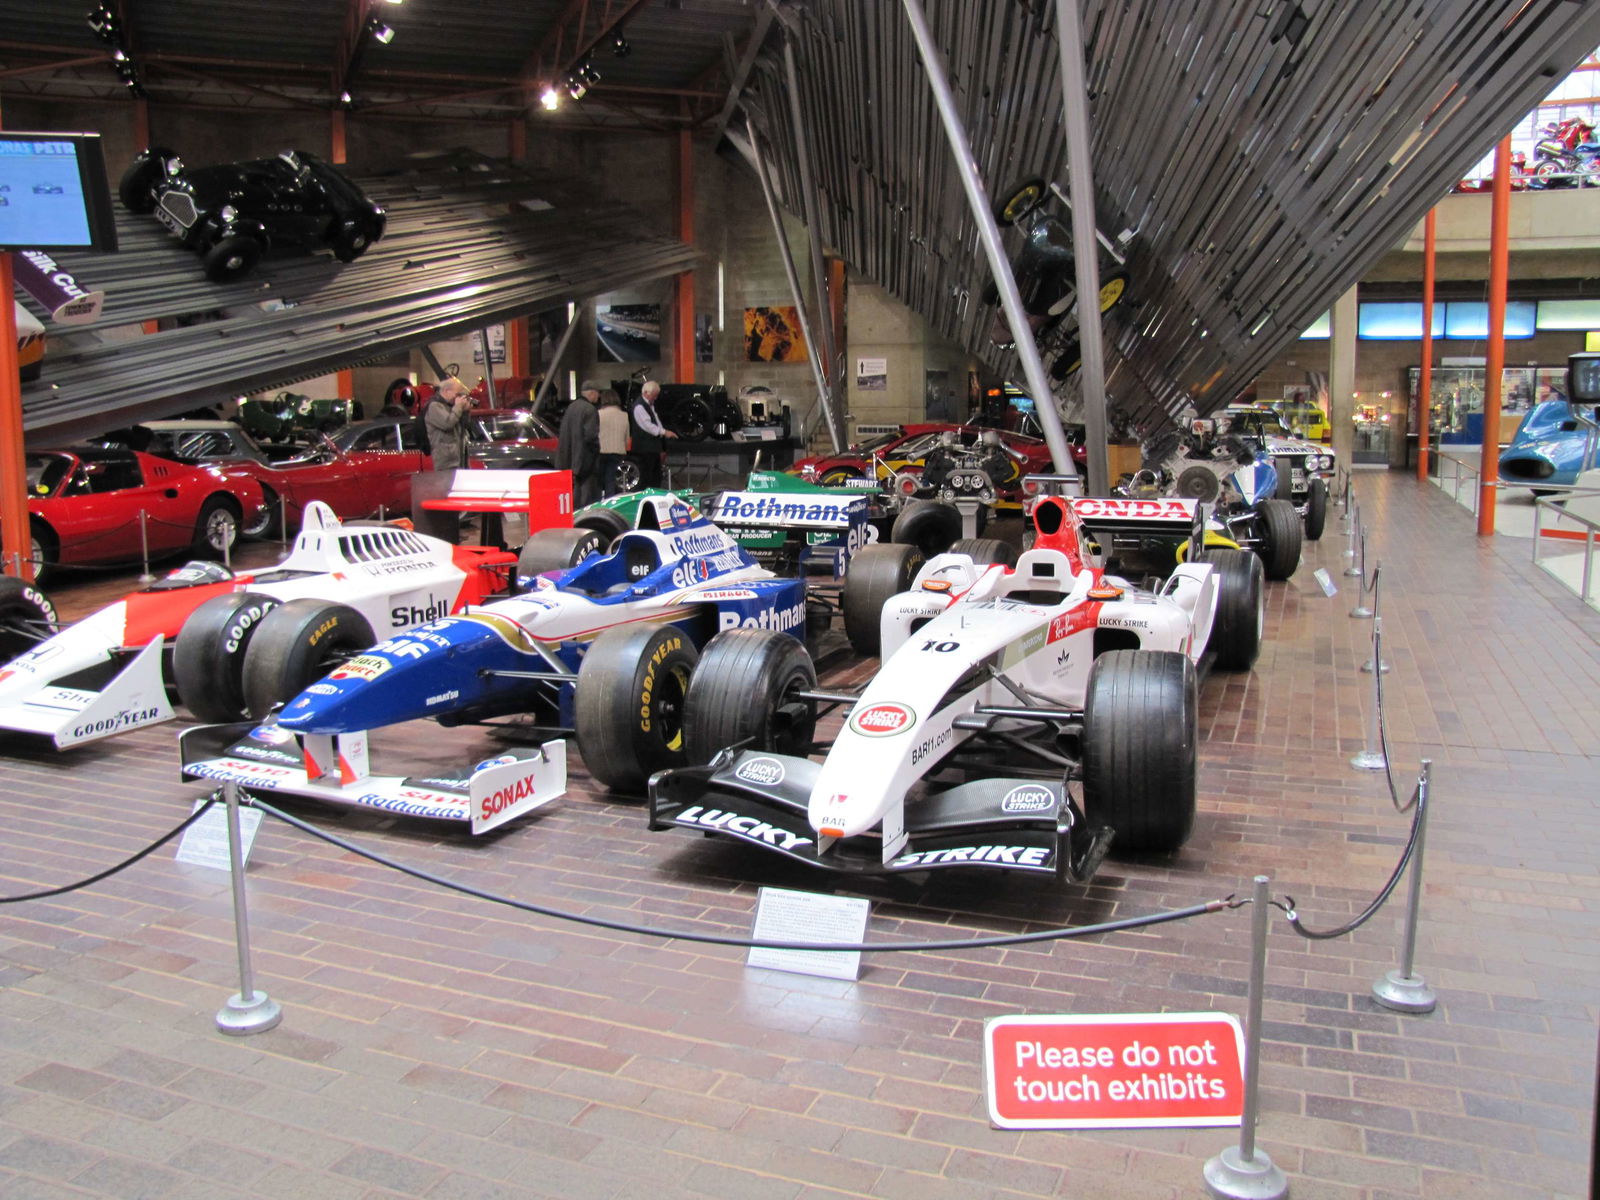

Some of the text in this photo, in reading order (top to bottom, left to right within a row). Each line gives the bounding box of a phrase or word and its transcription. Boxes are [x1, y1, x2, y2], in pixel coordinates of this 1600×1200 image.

[845, 479, 879, 488] STEWART
[558, 492, 571, 515] 11
[721, 496, 850, 523] Rothmans
[674, 532, 725, 558] Rothmans
[741, 532, 773, 541] PRODUCER
[384, 561, 437, 575] HONDA
[631, 565, 650, 576] elf
[838, 546, 846, 577] 5
[672, 560, 698, 588] elf
[391, 600, 448, 628] Shell
[921, 608, 943, 616] STRIKE
[308, 616, 339, 647] EAGLE
[1099, 617, 1149, 629] LUCKY STRIKE
[920, 641, 961, 653] 10
[860, 717, 902, 728] STRIKE
[868, 709, 905, 722] LUCKY
[911, 726, 953, 766] BARf1.com
[186, 763, 279, 789] Rothmans
[738, 770, 777, 785] STRIKE
[745, 761, 781, 777] LUCKY
[357, 793, 466, 820] Rothmans
[481, 773, 537, 822] SONAX
[1006, 802, 1046, 812] STRIKE
[1011, 792, 1049, 804] LUCKY
[821, 816, 847, 828] BAR
[676, 806, 1051, 867] LUCKY STRIKE
[1015, 1040, 1218, 1068] Please do not
[1013, 1072, 1226, 1102] touch exhibits
